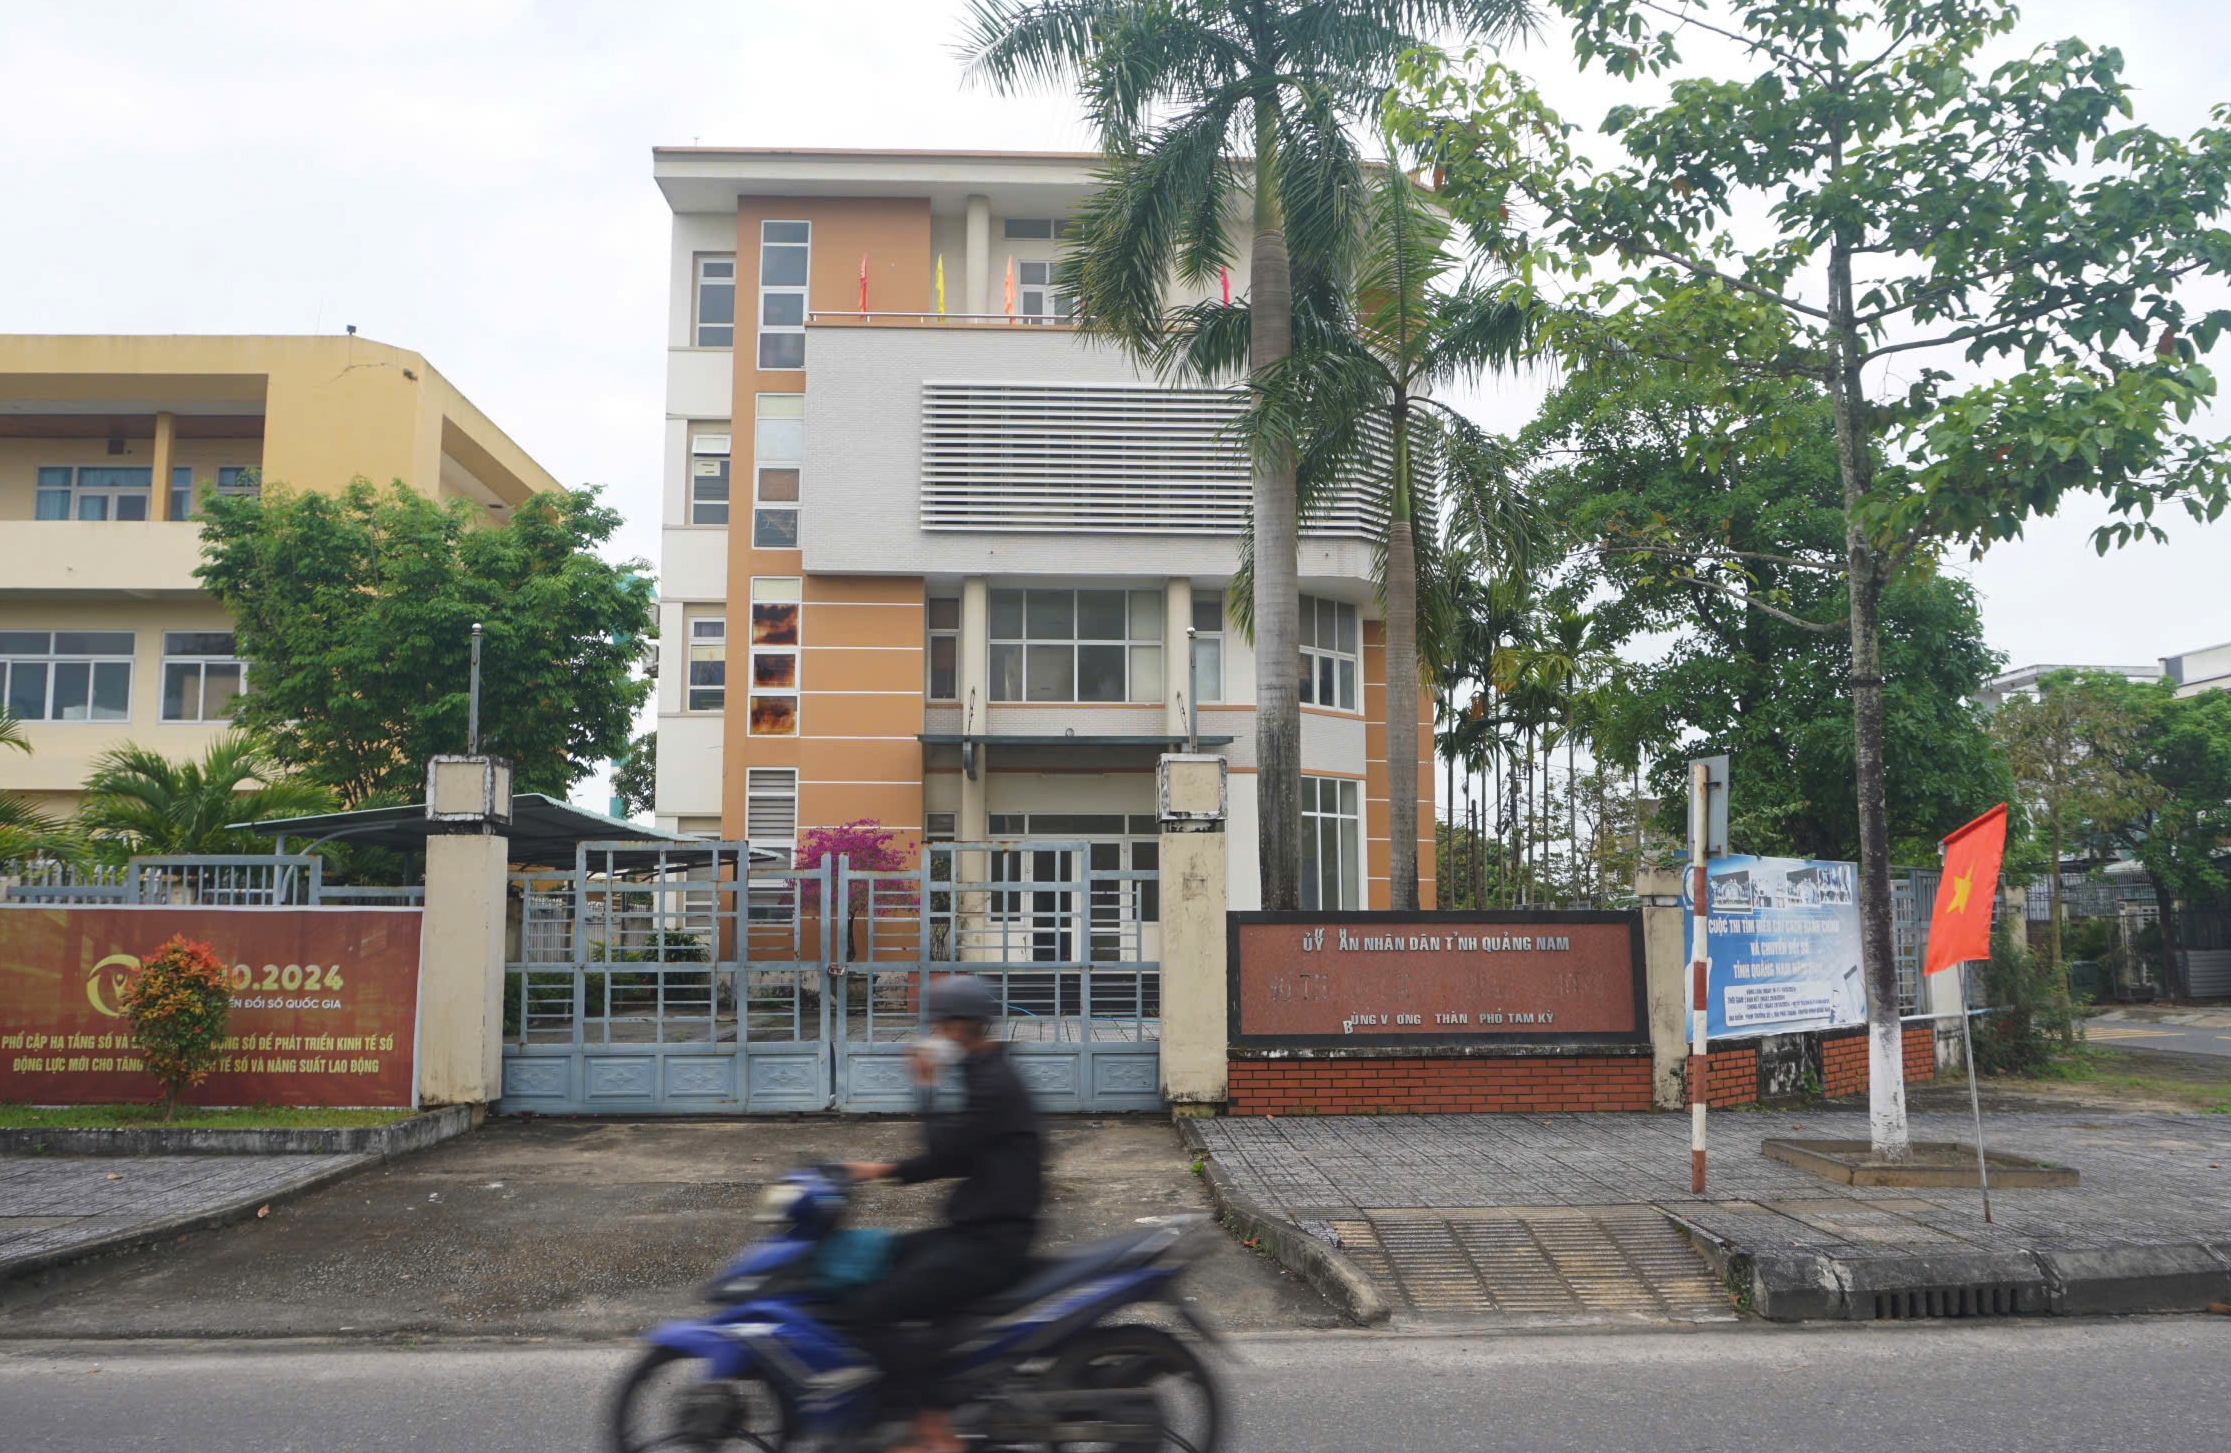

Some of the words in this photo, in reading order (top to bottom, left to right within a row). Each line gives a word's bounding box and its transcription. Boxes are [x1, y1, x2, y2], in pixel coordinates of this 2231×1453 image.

[1364, 933, 1405, 951] NHÂN
[1409, 933, 1440, 951] DÂN
[1444, 931, 1478, 951] TNH
[1481, 931, 1532, 952] QUẢNG
[1536, 936, 1570, 951] NAM
[267, 996, 283, 1009] SỐ
[285, 996, 319, 1009] QUỐC
[321, 999, 342, 1009] GIA
[1507, 1013, 1534, 1023] TAM
[1538, 1009, 1554, 1023] KỲ
[26, 1032, 48, 1052] CẬP
[50, 1035, 65, 1052] HẠ
[97, 1031, 113, 1049] SỐ
[115, 1033, 128, 1049] VÀ
[242, 1032, 257, 1050] SỐ
[275, 1034, 302, 1050] PHÁT
[336, 1037, 362, 1050] KINH
[364, 1033, 377, 1050] TẾ
[379, 1032, 393, 1050] SỐ
[13, 1055, 43, 1074] ĐỘNG
[45, 1056, 66, 1074] LỰC
[92, 1057, 113, 1072] CHO
[219, 1054, 232, 1072] TẾ
[234, 1054, 249, 1073] SỐ
[251, 1056, 264, 1073] VÀ
[267, 1056, 297, 1073] NĂNG
[299, 1054, 326, 1073] SUẤT
[328, 1059, 348, 1073] LAO
[350, 1056, 379, 1075] ĐỘNG
